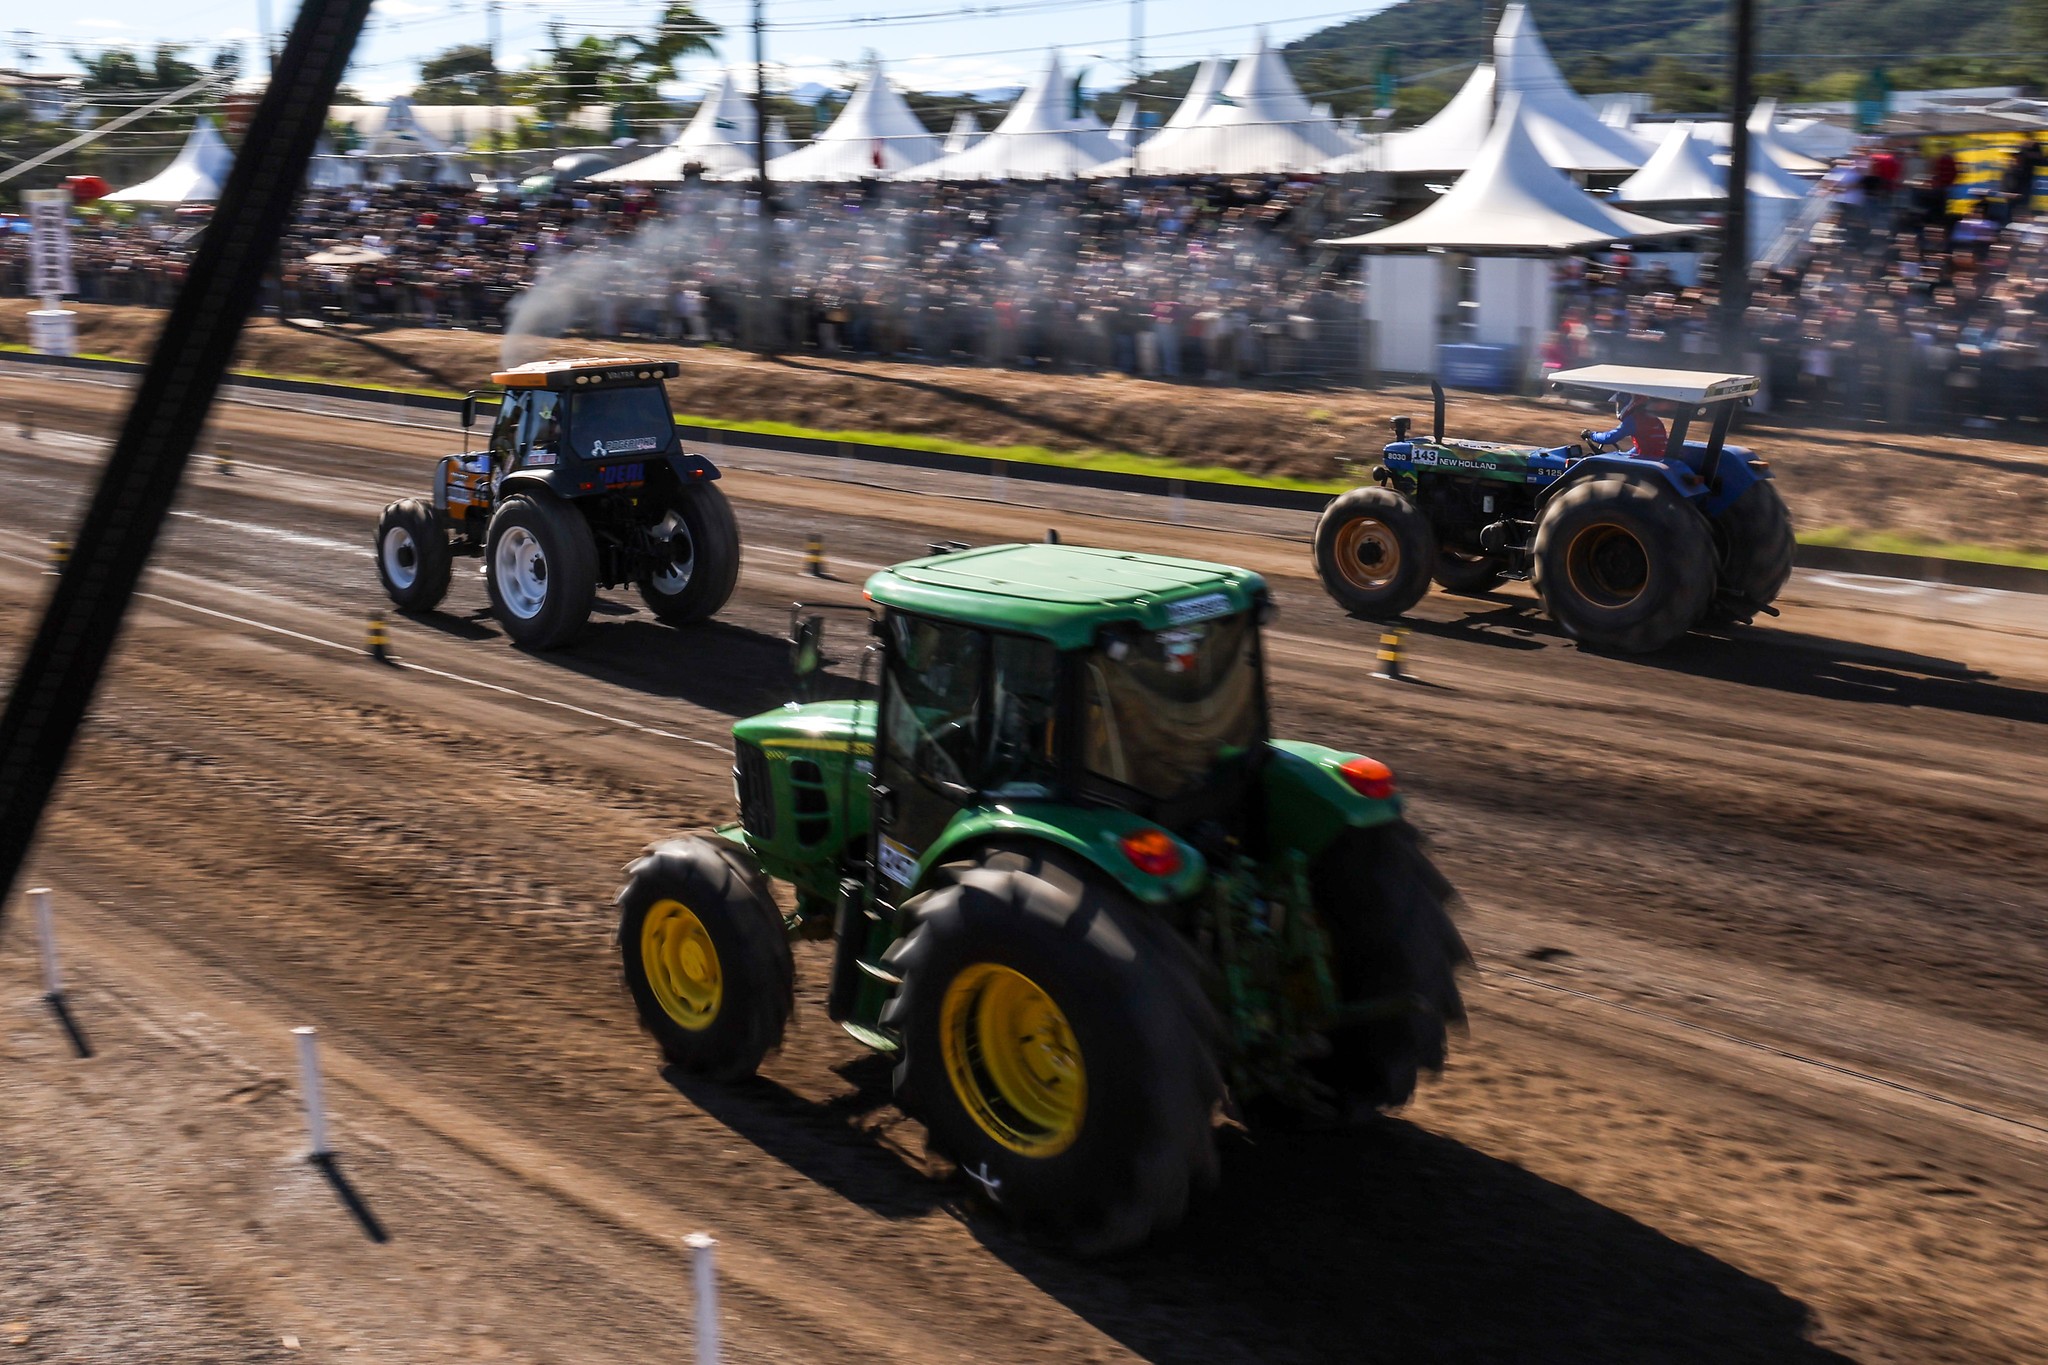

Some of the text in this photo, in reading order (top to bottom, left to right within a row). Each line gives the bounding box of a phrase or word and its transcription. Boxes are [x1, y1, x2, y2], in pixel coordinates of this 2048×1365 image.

[1387, 452, 1407, 461] 8030
[1413, 449, 1436, 462] 143
[1439, 458, 1458, 466] NEW
[1458, 460, 1497, 470] HOLLAND
[1545, 469, 1562, 477] 125
